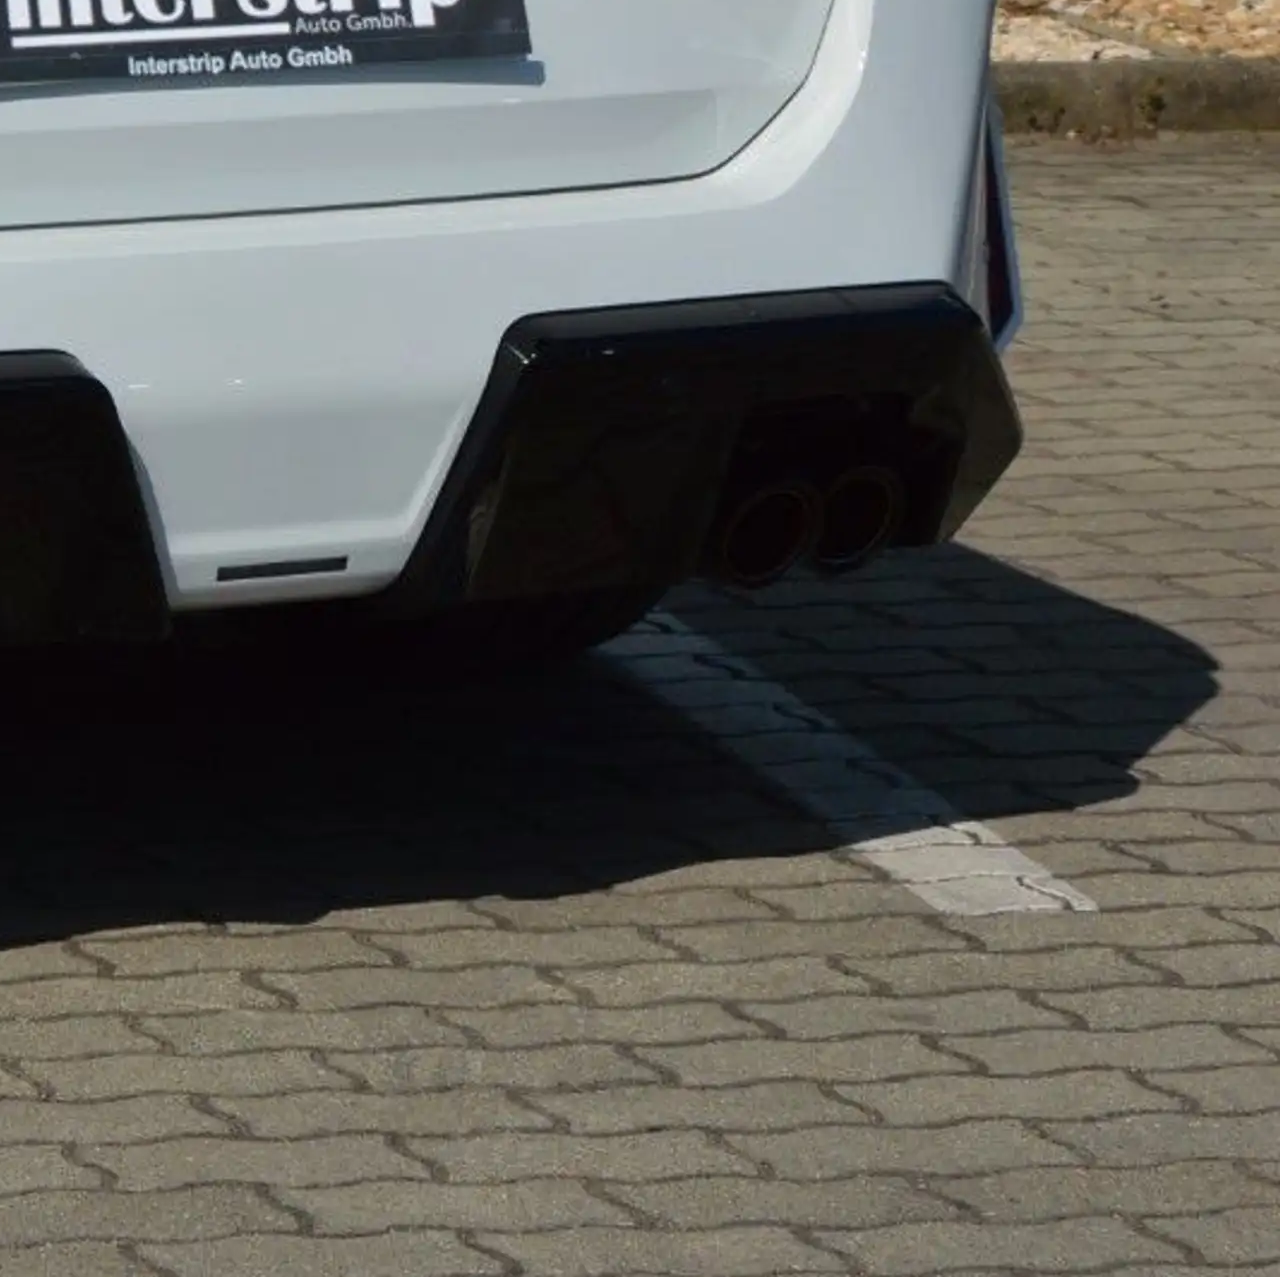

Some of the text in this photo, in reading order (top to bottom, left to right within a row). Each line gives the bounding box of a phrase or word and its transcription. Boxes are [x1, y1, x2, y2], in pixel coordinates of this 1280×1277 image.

[295, 16, 341, 35] Auto
[127, 44, 353, 76] Interstrip Auto Gmbh
